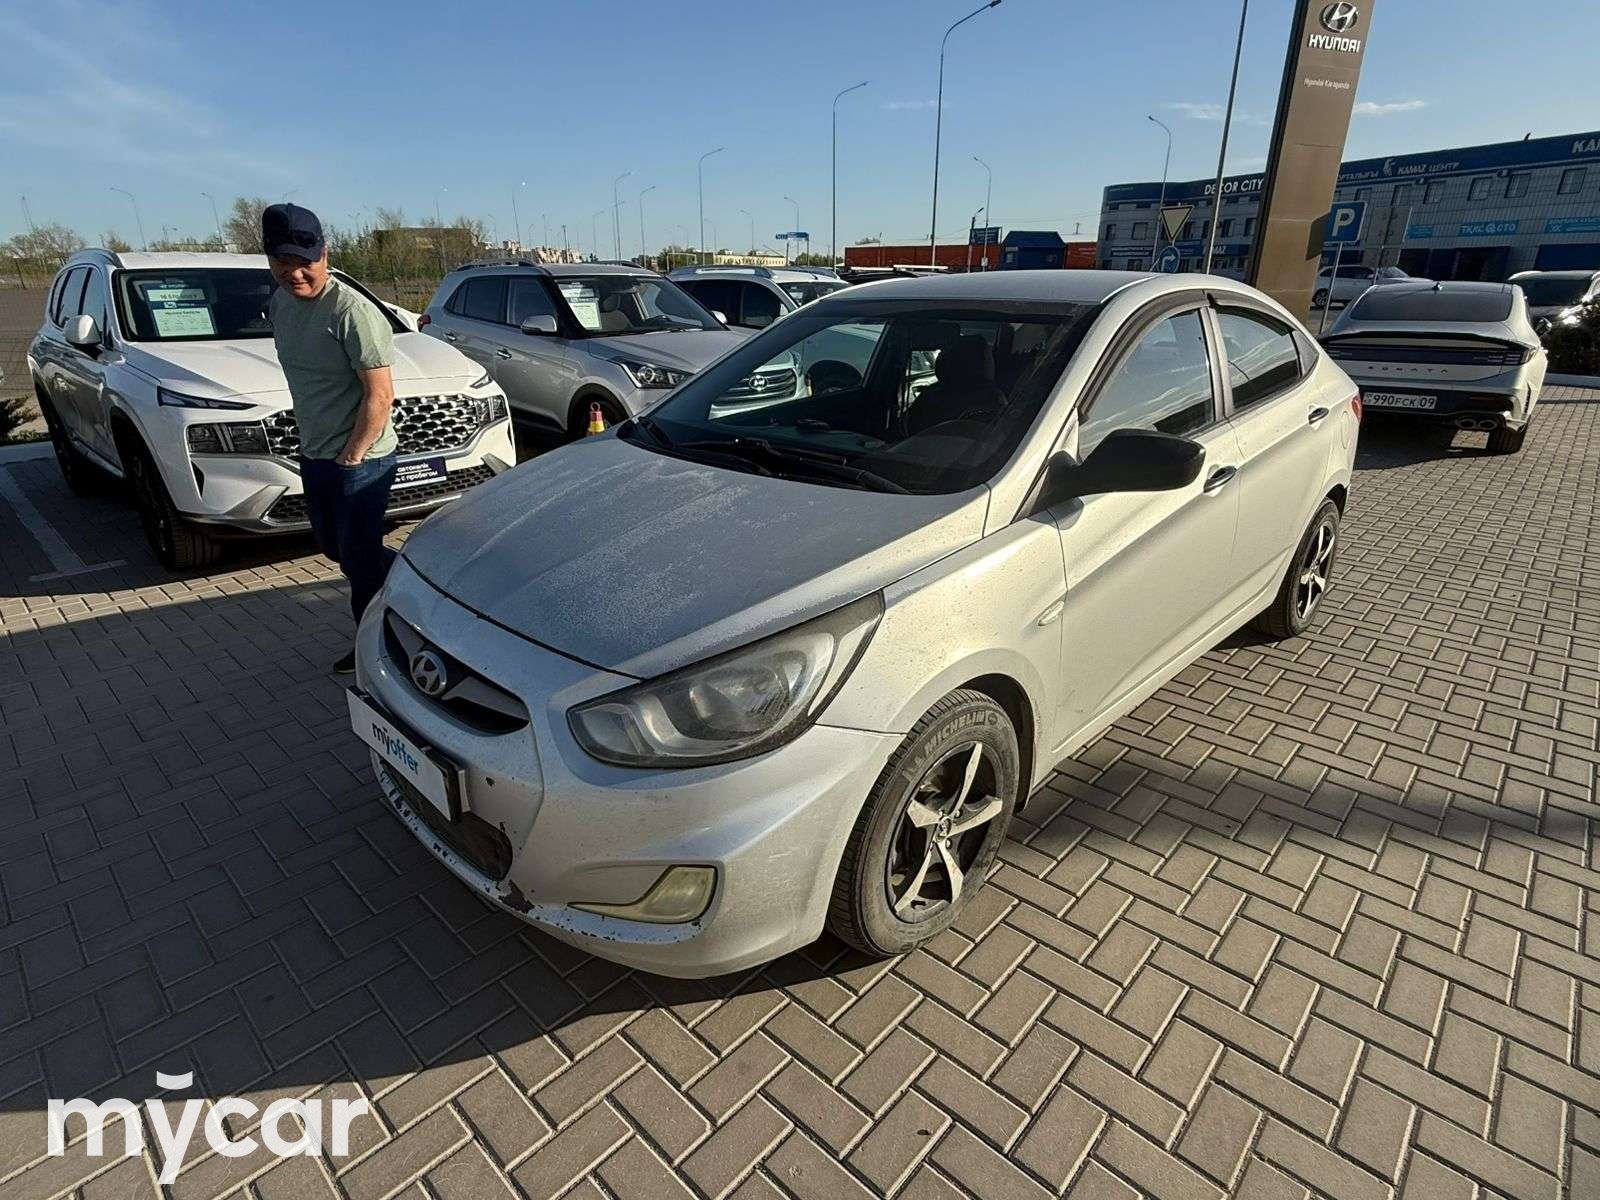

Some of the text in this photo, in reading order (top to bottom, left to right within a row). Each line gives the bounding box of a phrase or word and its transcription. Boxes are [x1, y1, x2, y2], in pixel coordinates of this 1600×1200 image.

[1308, 34, 1361, 53] HYUNDAI
[1240, 178, 1265, 193] CITY
[1331, 208, 1356, 237] P
[924, 710, 986, 757] MICHELIN
